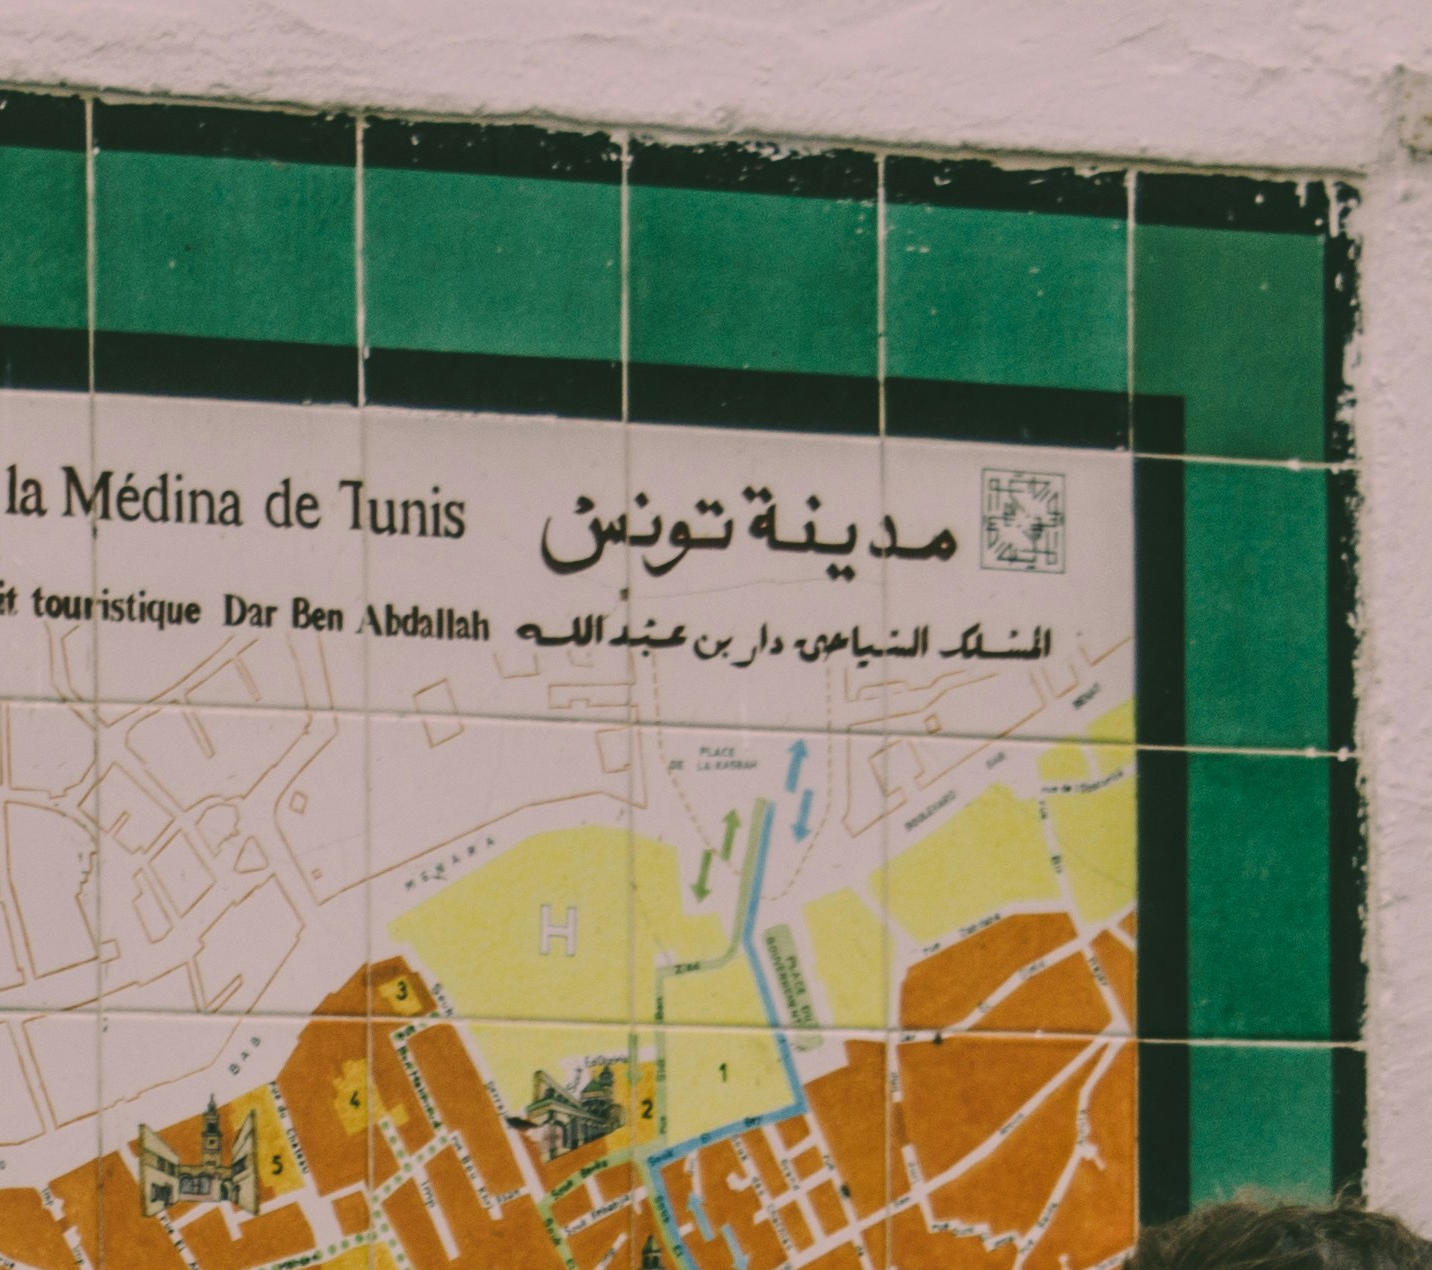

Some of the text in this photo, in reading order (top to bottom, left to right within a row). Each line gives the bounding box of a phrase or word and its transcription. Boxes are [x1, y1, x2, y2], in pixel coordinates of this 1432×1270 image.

[6, 464, 465, 539] la Médina de Tunis
[541, 492, 733, 577] تونس
[742, 485, 957, 582] مدينة
[32, 586, 201, 631] touristique
[224, 593, 278, 627] Dar
[292, 597, 343, 632] Ben
[356, 603, 490, 641] Abdallah
[693, 633, 733, 661] بن
[731, 621, 784, 668] دار
[395, 980, 408, 1001] 3
[718, 1062, 729, 1083] 1
[349, 1090, 361, 1109] 4
[641, 1099, 653, 1120] 2
[271, 1155, 283, 1175] 5
